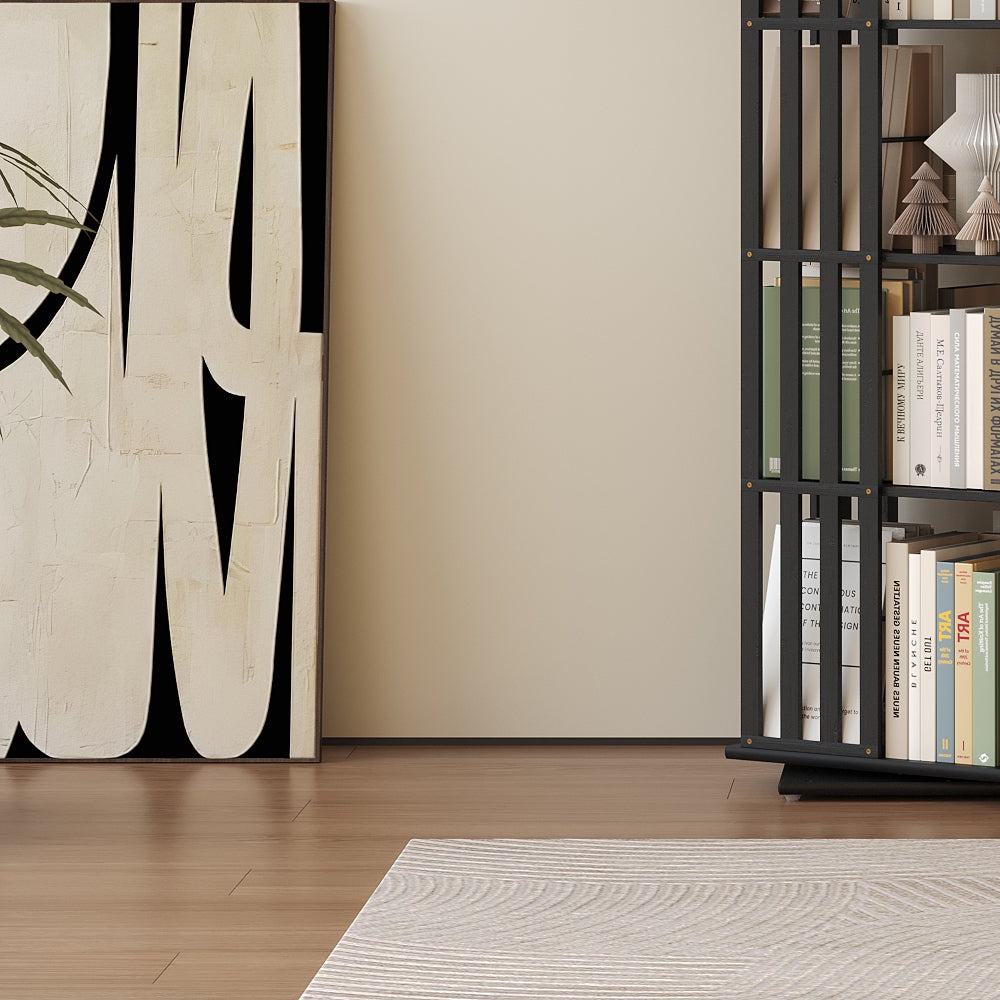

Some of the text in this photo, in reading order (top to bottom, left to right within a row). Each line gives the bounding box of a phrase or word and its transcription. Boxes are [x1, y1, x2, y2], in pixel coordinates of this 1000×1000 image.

[916, 330, 924, 400] ДАНТЕ АЛИГЬЕРИ
[803, 570, 819, 580] THE
